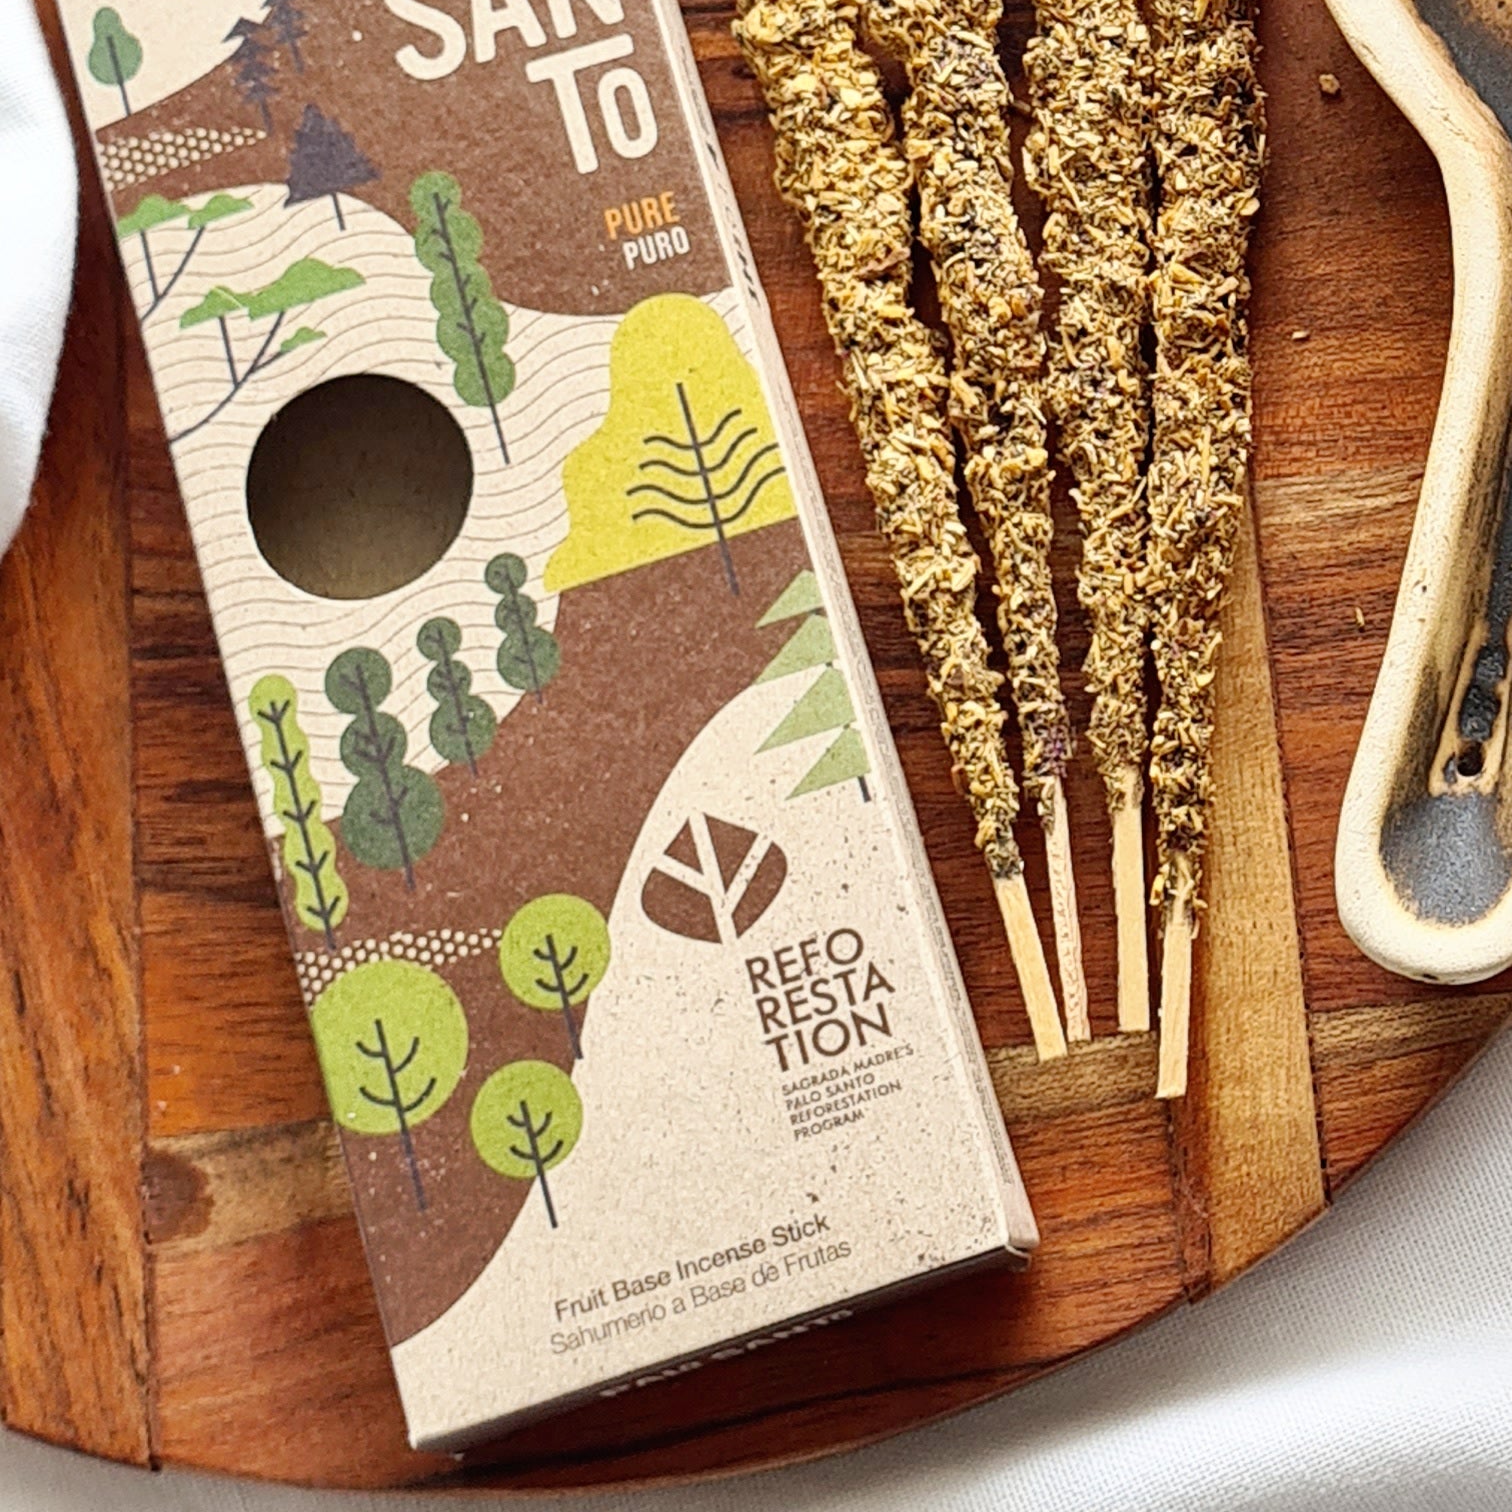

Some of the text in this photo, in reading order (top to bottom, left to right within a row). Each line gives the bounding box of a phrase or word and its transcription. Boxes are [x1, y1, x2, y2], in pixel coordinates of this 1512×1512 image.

[525, 33, 661, 175] TO
[603, 191, 681, 240] PURE
[622, 226, 691, 271] PURO
[745, 927, 865, 995] REFO
[755, 961, 897, 1035] RESTA
[764, 1001, 893, 1073] TION
[781, 1065, 850, 1097] SAGRADA
[785, 1072, 876, 1112] PALO SANTO
[789, 1079, 902, 1126] REFORESTATION
[793, 1109, 866, 1142] PROGRAM
[554, 1212, 831, 1323] Fruit Base Incense Stick
[549, 1238, 853, 1356] Sahumerio a Base de Frutas
